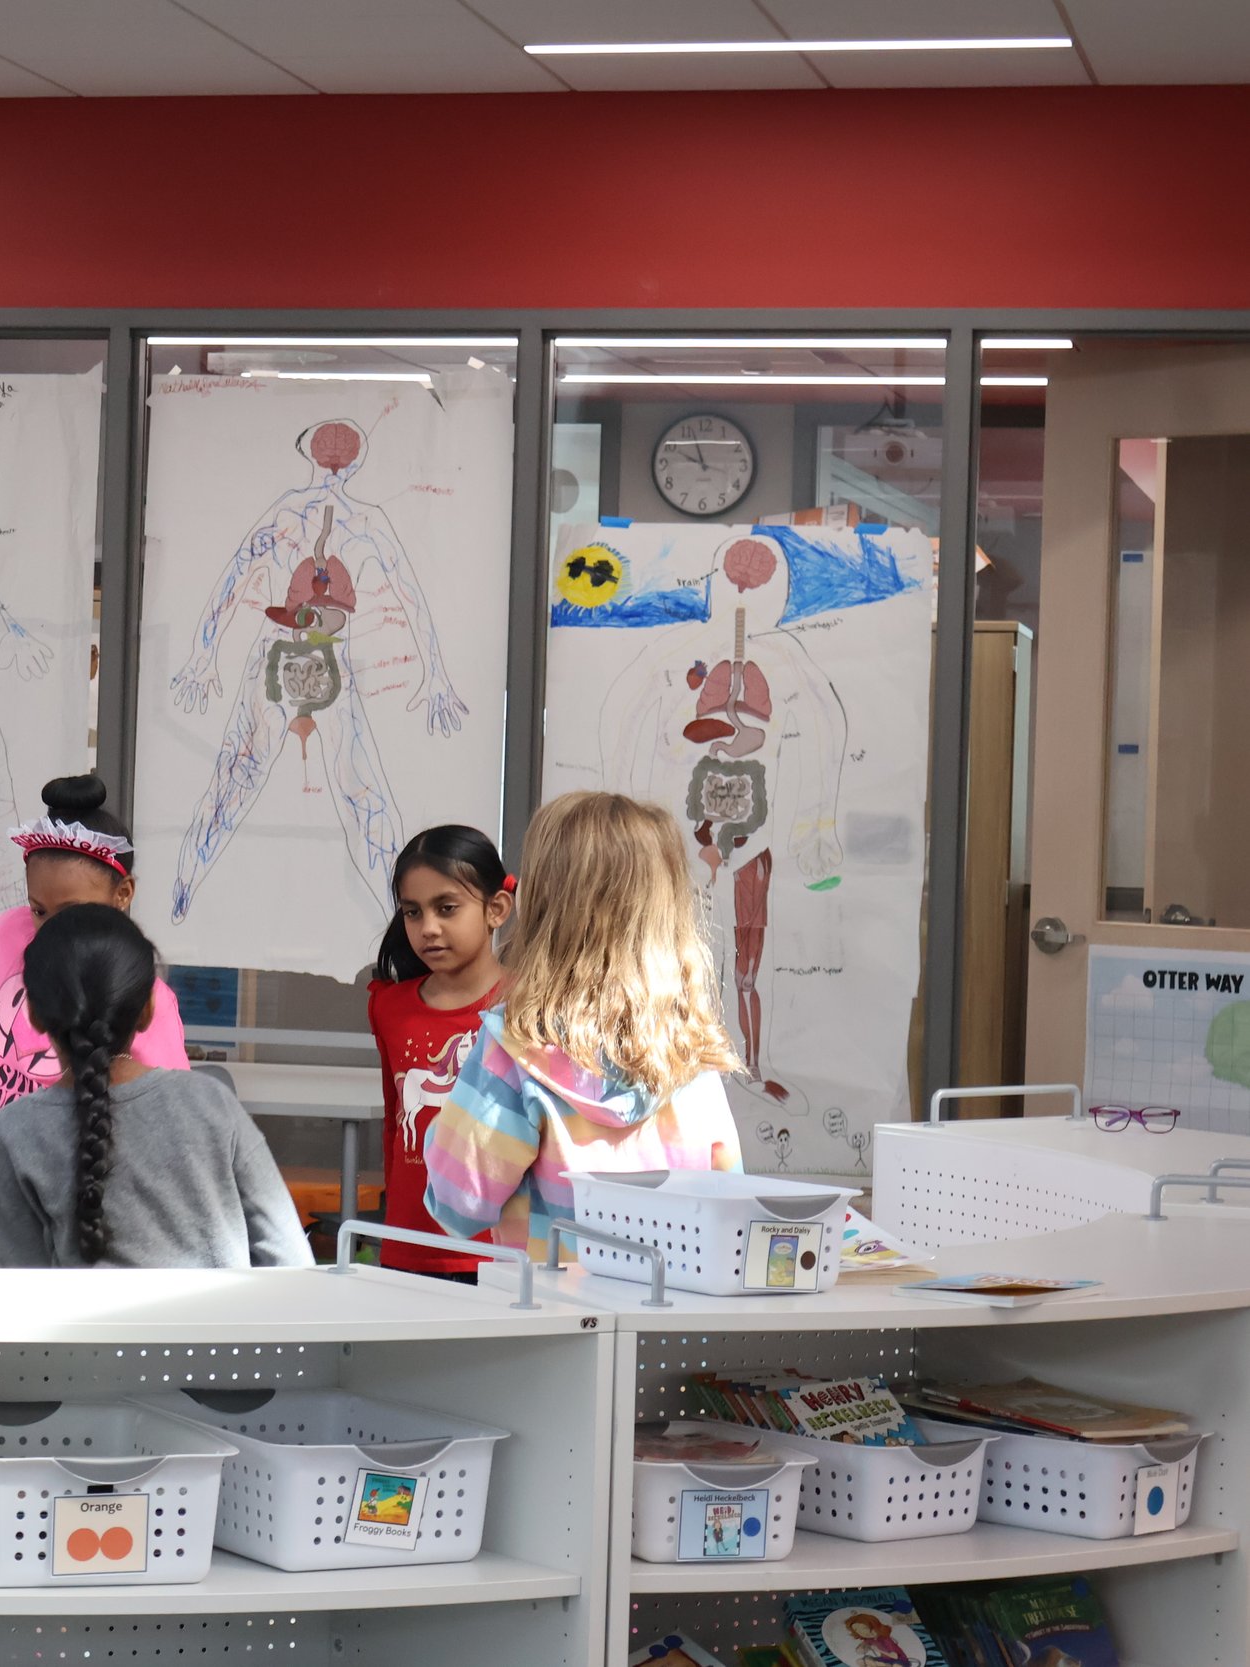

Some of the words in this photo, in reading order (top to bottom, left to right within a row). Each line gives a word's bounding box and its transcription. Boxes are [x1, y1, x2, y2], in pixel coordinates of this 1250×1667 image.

[698, 419, 713, 432] 12
[738, 458, 748, 472] 3
[664, 477, 674, 490] 8
[732, 479, 741, 491] 4
[679, 492, 689, 506] 7
[698, 497, 708, 511] 6
[717, 493, 726, 507] 5
[1143, 970, 1200, 991] OTTER
[1205, 973, 1245, 994] WAY
[761, 1225, 780, 1236] Rocky
[781, 1226, 794, 1234] and
[794, 1226, 811, 1236] Daisy
[580, 1316, 598, 1329] VS
[694, 1494, 713, 1502] Heidi
[80, 1502, 123, 1514] Orange
[353, 1522, 384, 1536] Froggy
[385, 1526, 412, 1538] Books
